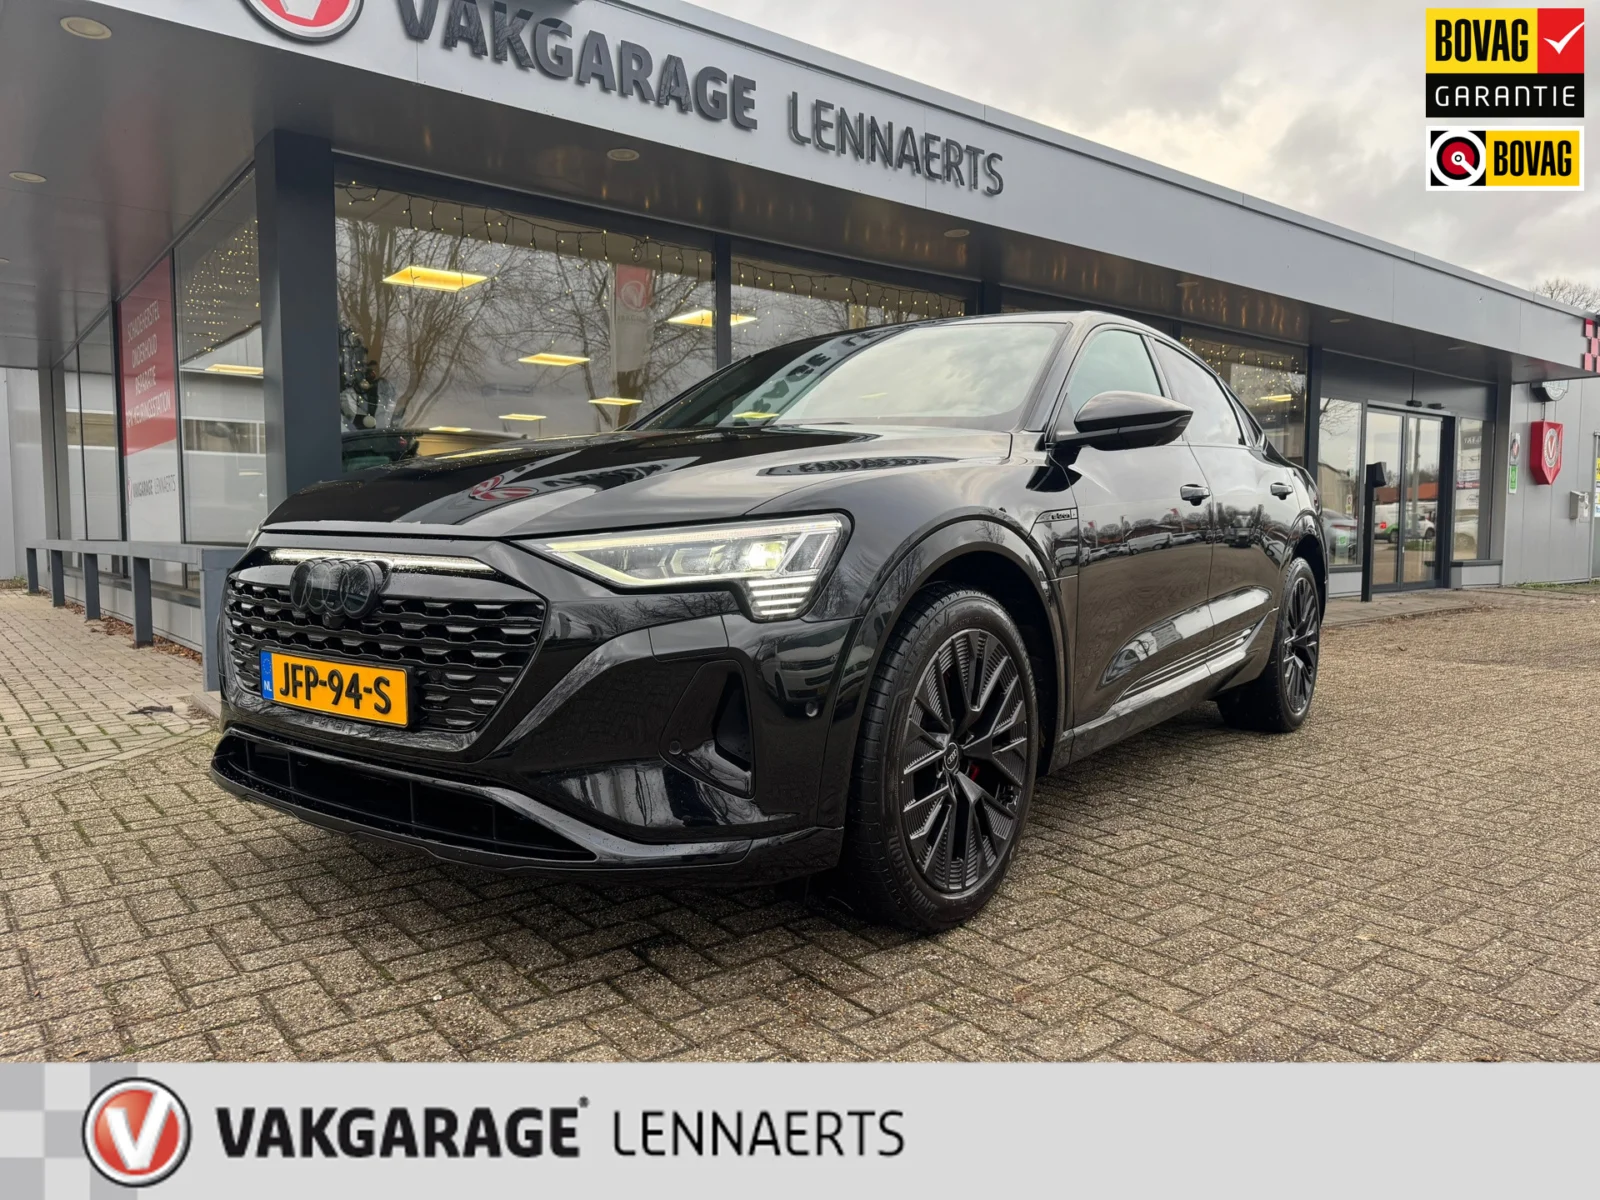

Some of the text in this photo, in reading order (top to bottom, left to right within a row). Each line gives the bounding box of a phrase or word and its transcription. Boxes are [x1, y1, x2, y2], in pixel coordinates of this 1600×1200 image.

[398, 0, 1004, 195] VAKGARAGE LENNAERTS
[263, 679, 273, 692] NL
[279, 662, 392, 714] JFP-94-S
